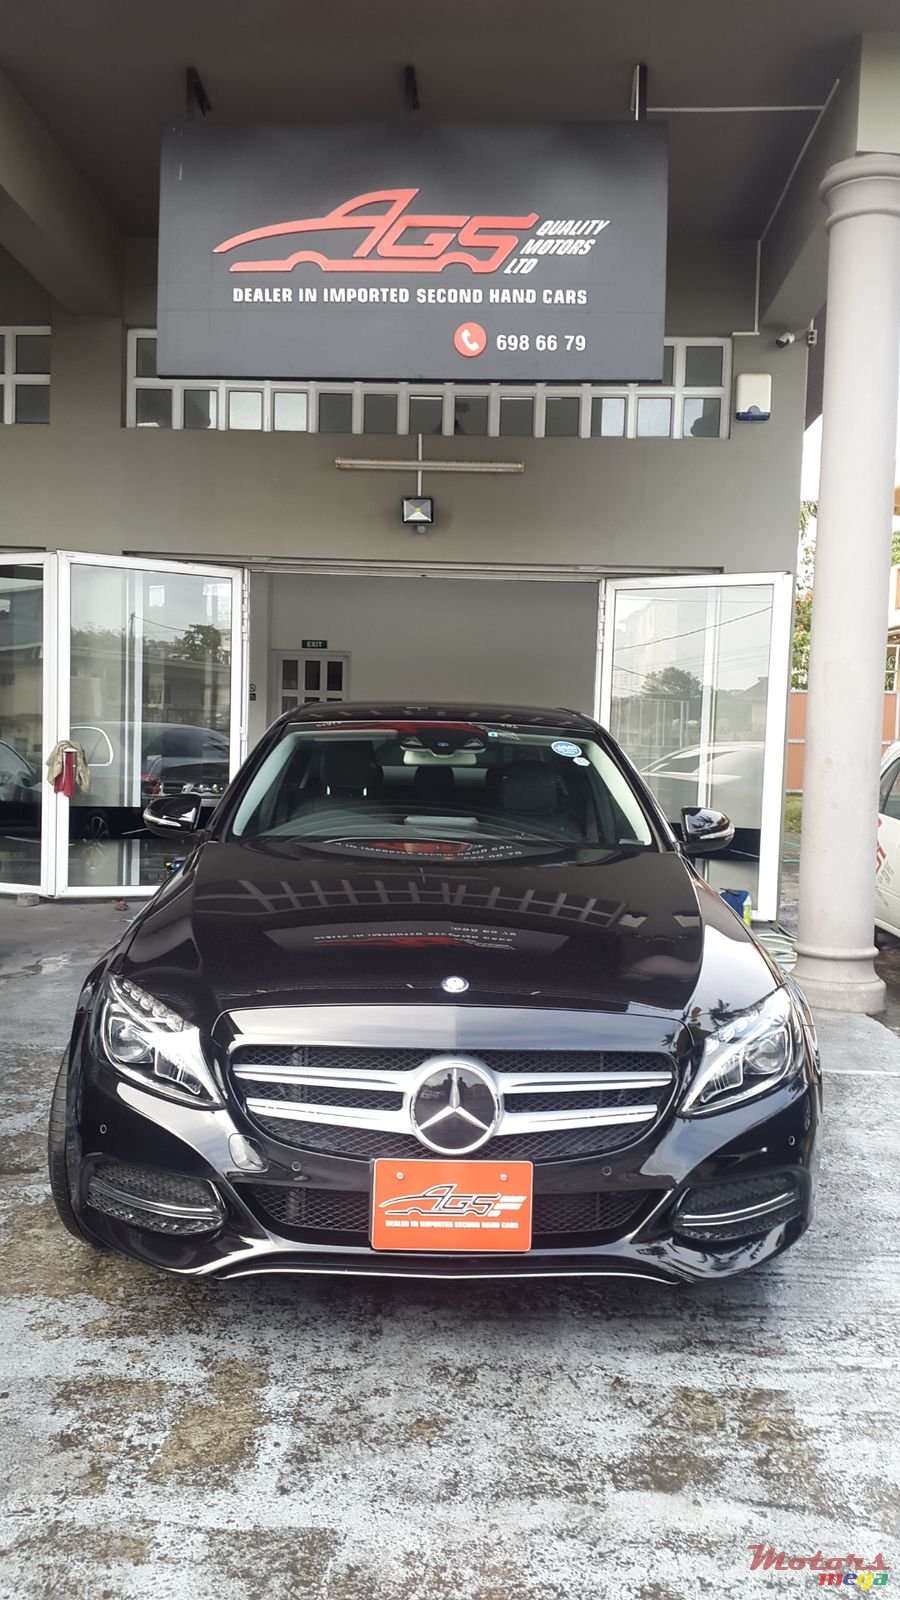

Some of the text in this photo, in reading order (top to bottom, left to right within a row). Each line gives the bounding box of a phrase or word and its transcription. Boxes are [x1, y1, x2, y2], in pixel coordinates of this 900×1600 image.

[212, 188, 539, 273] AGS
[536, 220, 610, 236] QUALITY
[520, 239, 596, 255] MOTORS
[503, 258, 539, 274] LTD
[232, 287, 588, 305] DEALER IN IMPORTED SECOND HAND CARS
[496, 334, 586, 351] 698 66 79
[306, 640, 323, 648] EXIT
[378, 1184, 502, 1217] AGS
